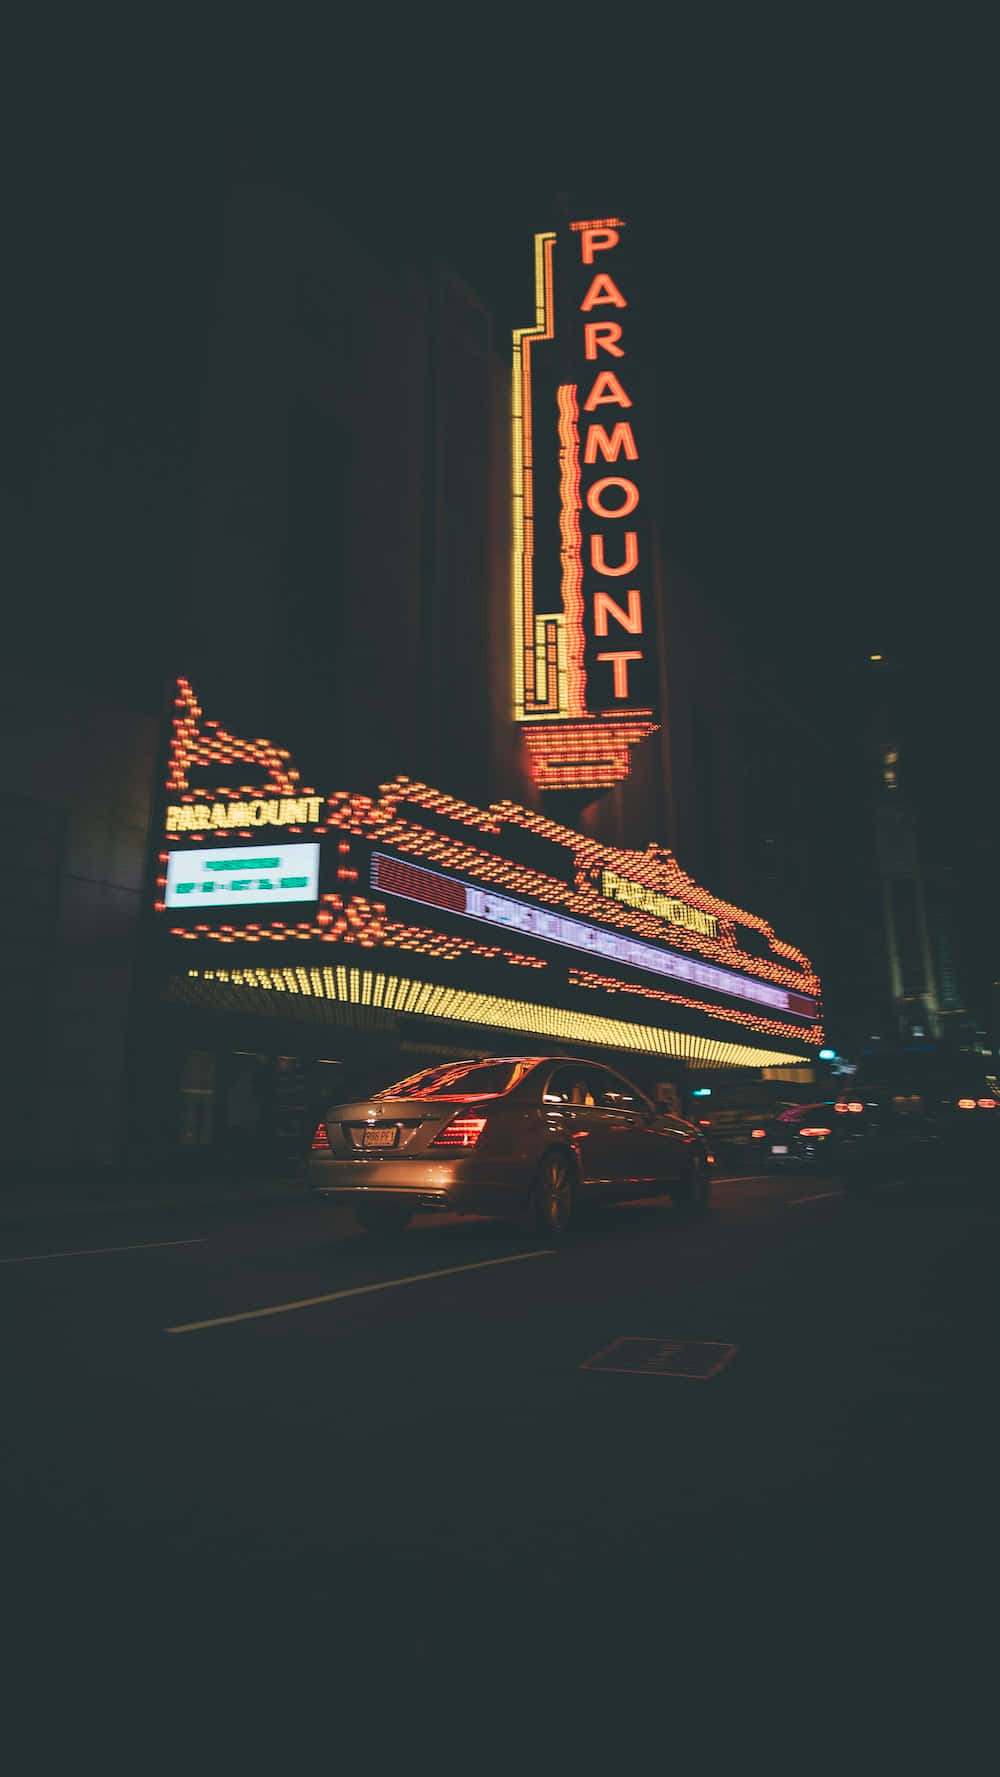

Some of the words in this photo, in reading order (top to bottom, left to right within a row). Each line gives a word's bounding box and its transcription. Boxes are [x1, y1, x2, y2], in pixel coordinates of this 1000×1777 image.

[580, 228, 644, 699] PARAMOUNT
[165, 797, 324, 831] PARAMOUNT
[602, 869, 718, 938] PARAMOUNT
